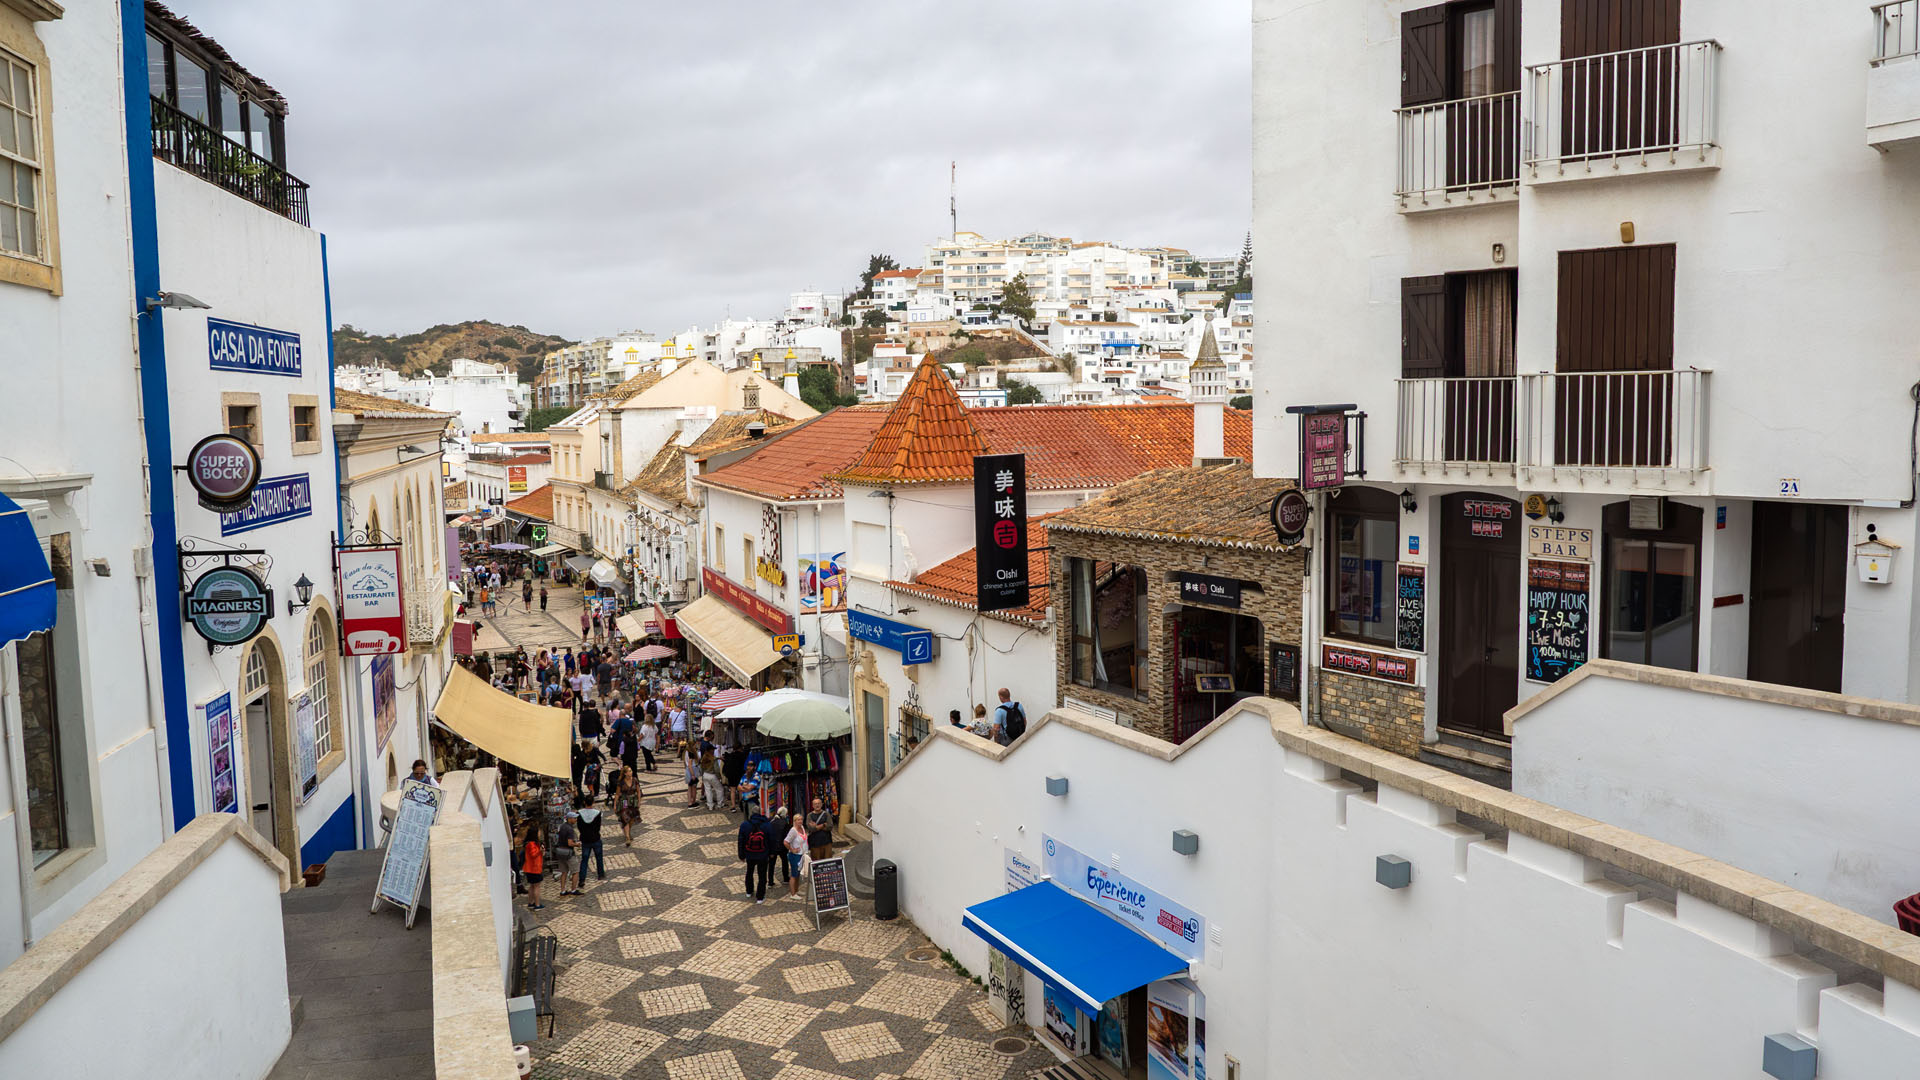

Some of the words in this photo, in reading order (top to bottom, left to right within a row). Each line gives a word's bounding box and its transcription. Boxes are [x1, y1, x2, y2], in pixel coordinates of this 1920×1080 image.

[211, 329, 246, 363] CASA
[248, 335, 265, 366] DA
[268, 338, 300, 369] FONTE
[1310, 418, 1340, 434] STEPS
[1316, 434, 1335, 453] BAR
[200, 456, 244, 468] SUPER
[202, 468, 242, 480] BOCK
[1781, 482, 1798, 493] 2A
[1282, 504, 1304, 515] SUPER
[1464, 500, 1511, 520] STEPS
[1284, 512, 1304, 523] BOCK
[1472, 520, 1502, 538] BAR
[1532, 528, 1590, 542] STEPS
[1543, 543, 1577, 556] BAR
[343, 567, 360, 580] Casa
[362, 562, 372, 570] da
[374, 564, 396, 580] Fonte
[996, 569, 1018, 580] Oishi
[1532, 568, 1561, 580] STEPS
[1566, 570, 1586, 582] BAR
[346, 592, 396, 600] RESTAURANTE
[1210, 584, 1224, 594] Oishi
[193, 600, 262, 613] MAGNERS
[1530, 591, 1557, 609] HAPPY
[1560, 592, 1588, 614] HOUR
[850, 616, 872, 636] algarve
[1328, 650, 1371, 672] STEPS
[1376, 658, 1407, 679] BAR
[1100, 869, 1108, 878] THE
[1088, 865, 1146, 908] Experience
[1118, 904, 1132, 916] Ticket
[1132, 909, 1144, 922] Office
[1160, 910, 1172, 922] BOOK
[1172, 916, 1182, 927] HERE
